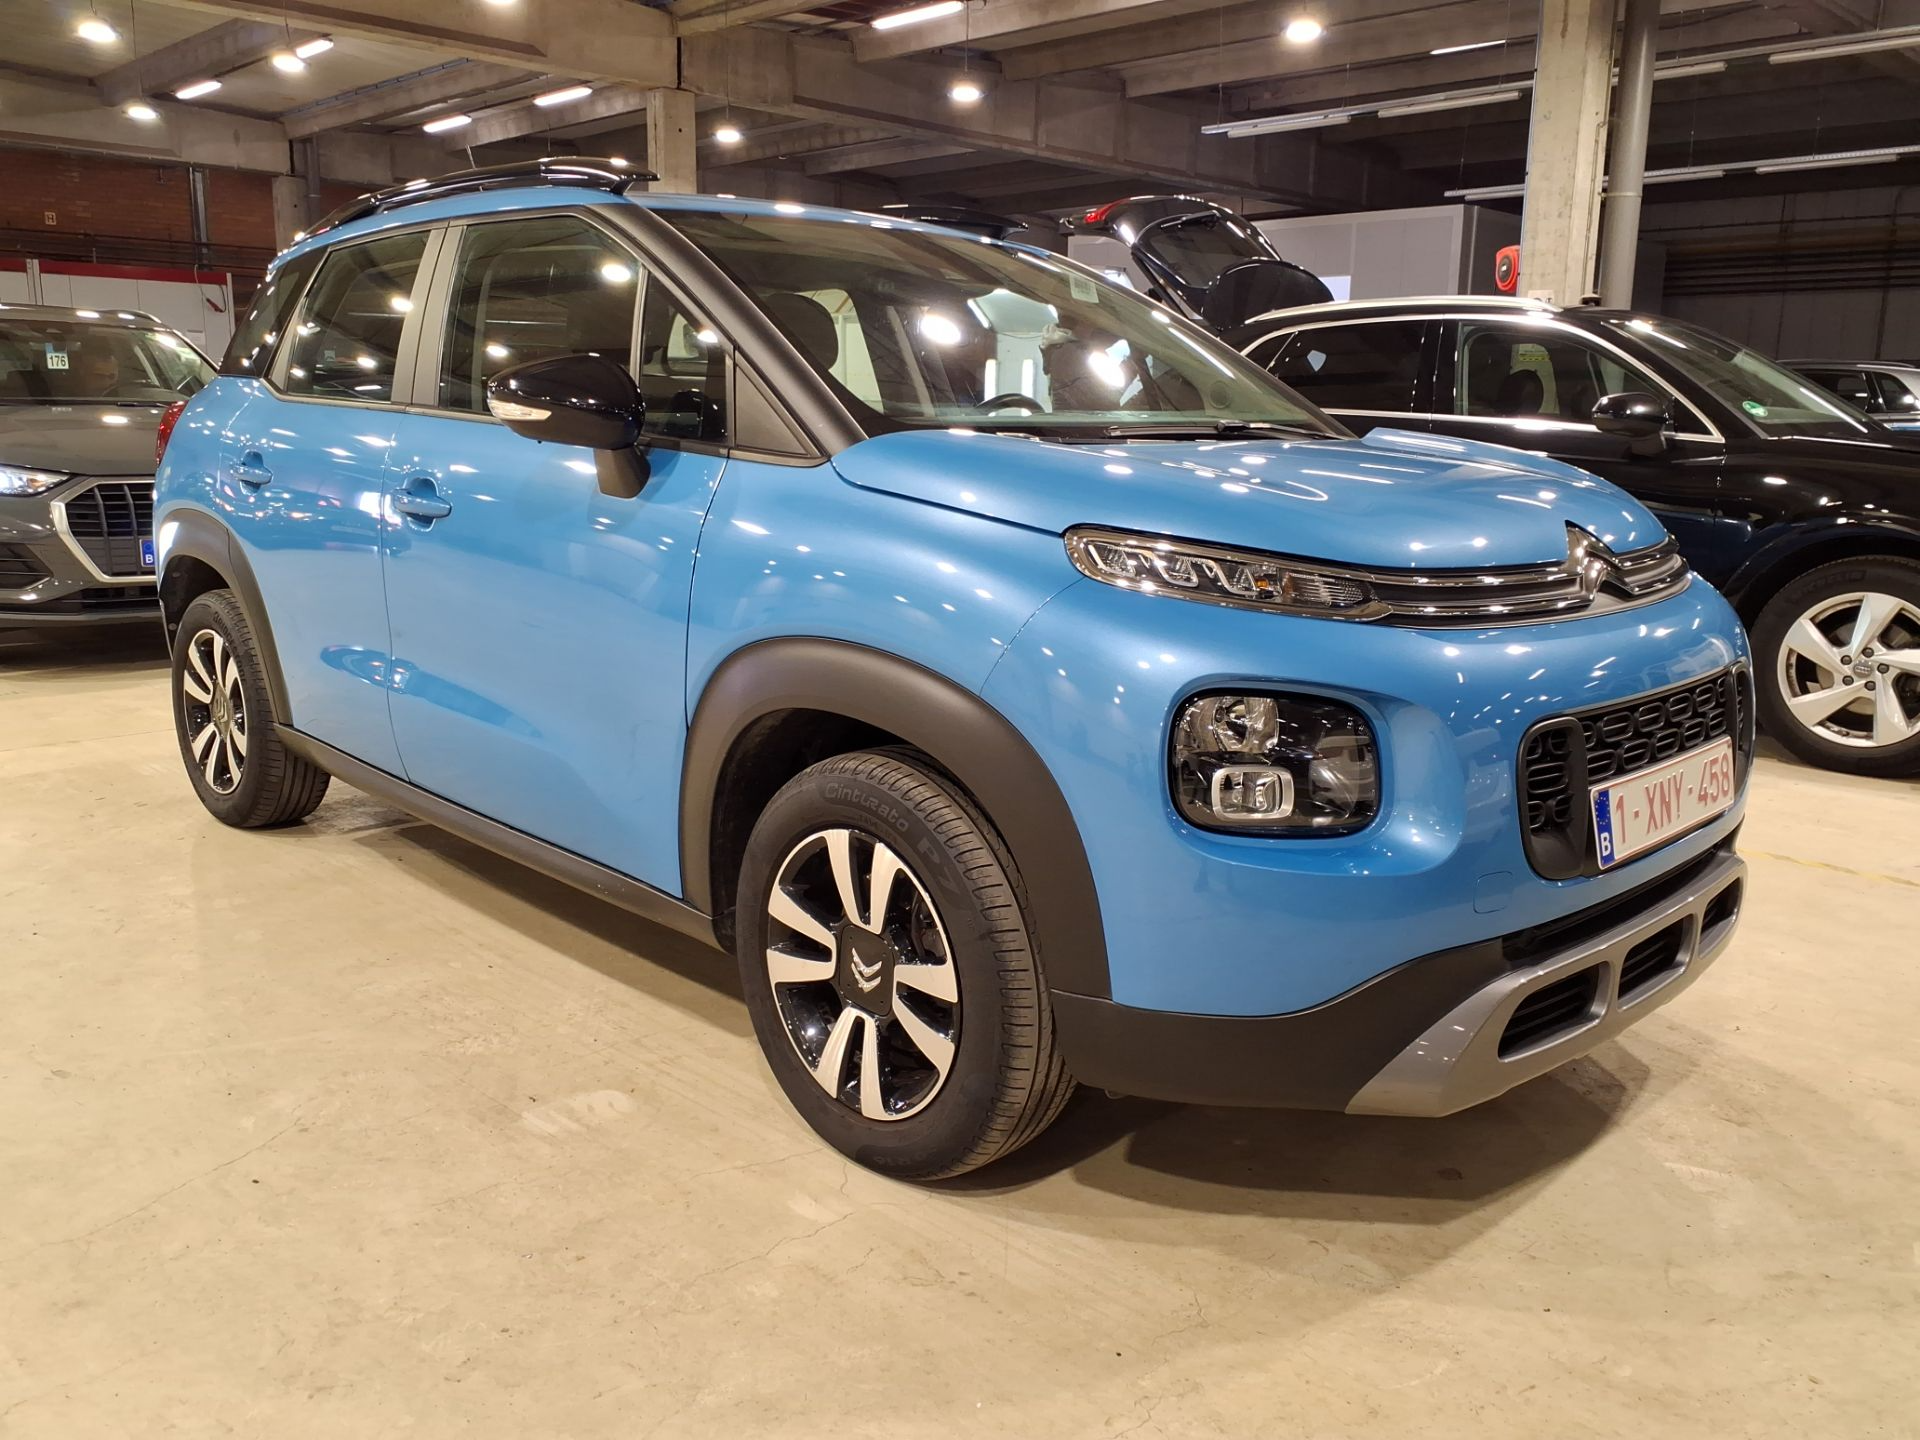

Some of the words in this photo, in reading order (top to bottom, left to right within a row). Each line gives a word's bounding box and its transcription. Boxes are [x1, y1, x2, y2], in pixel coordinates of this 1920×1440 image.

[49, 355, 67, 367] 176
[145, 554, 154, 564] B
[825, 782, 909, 832] Cinturato
[1616, 752, 1730, 843] 1-XNY-458
[1600, 832, 1611, 857] B
